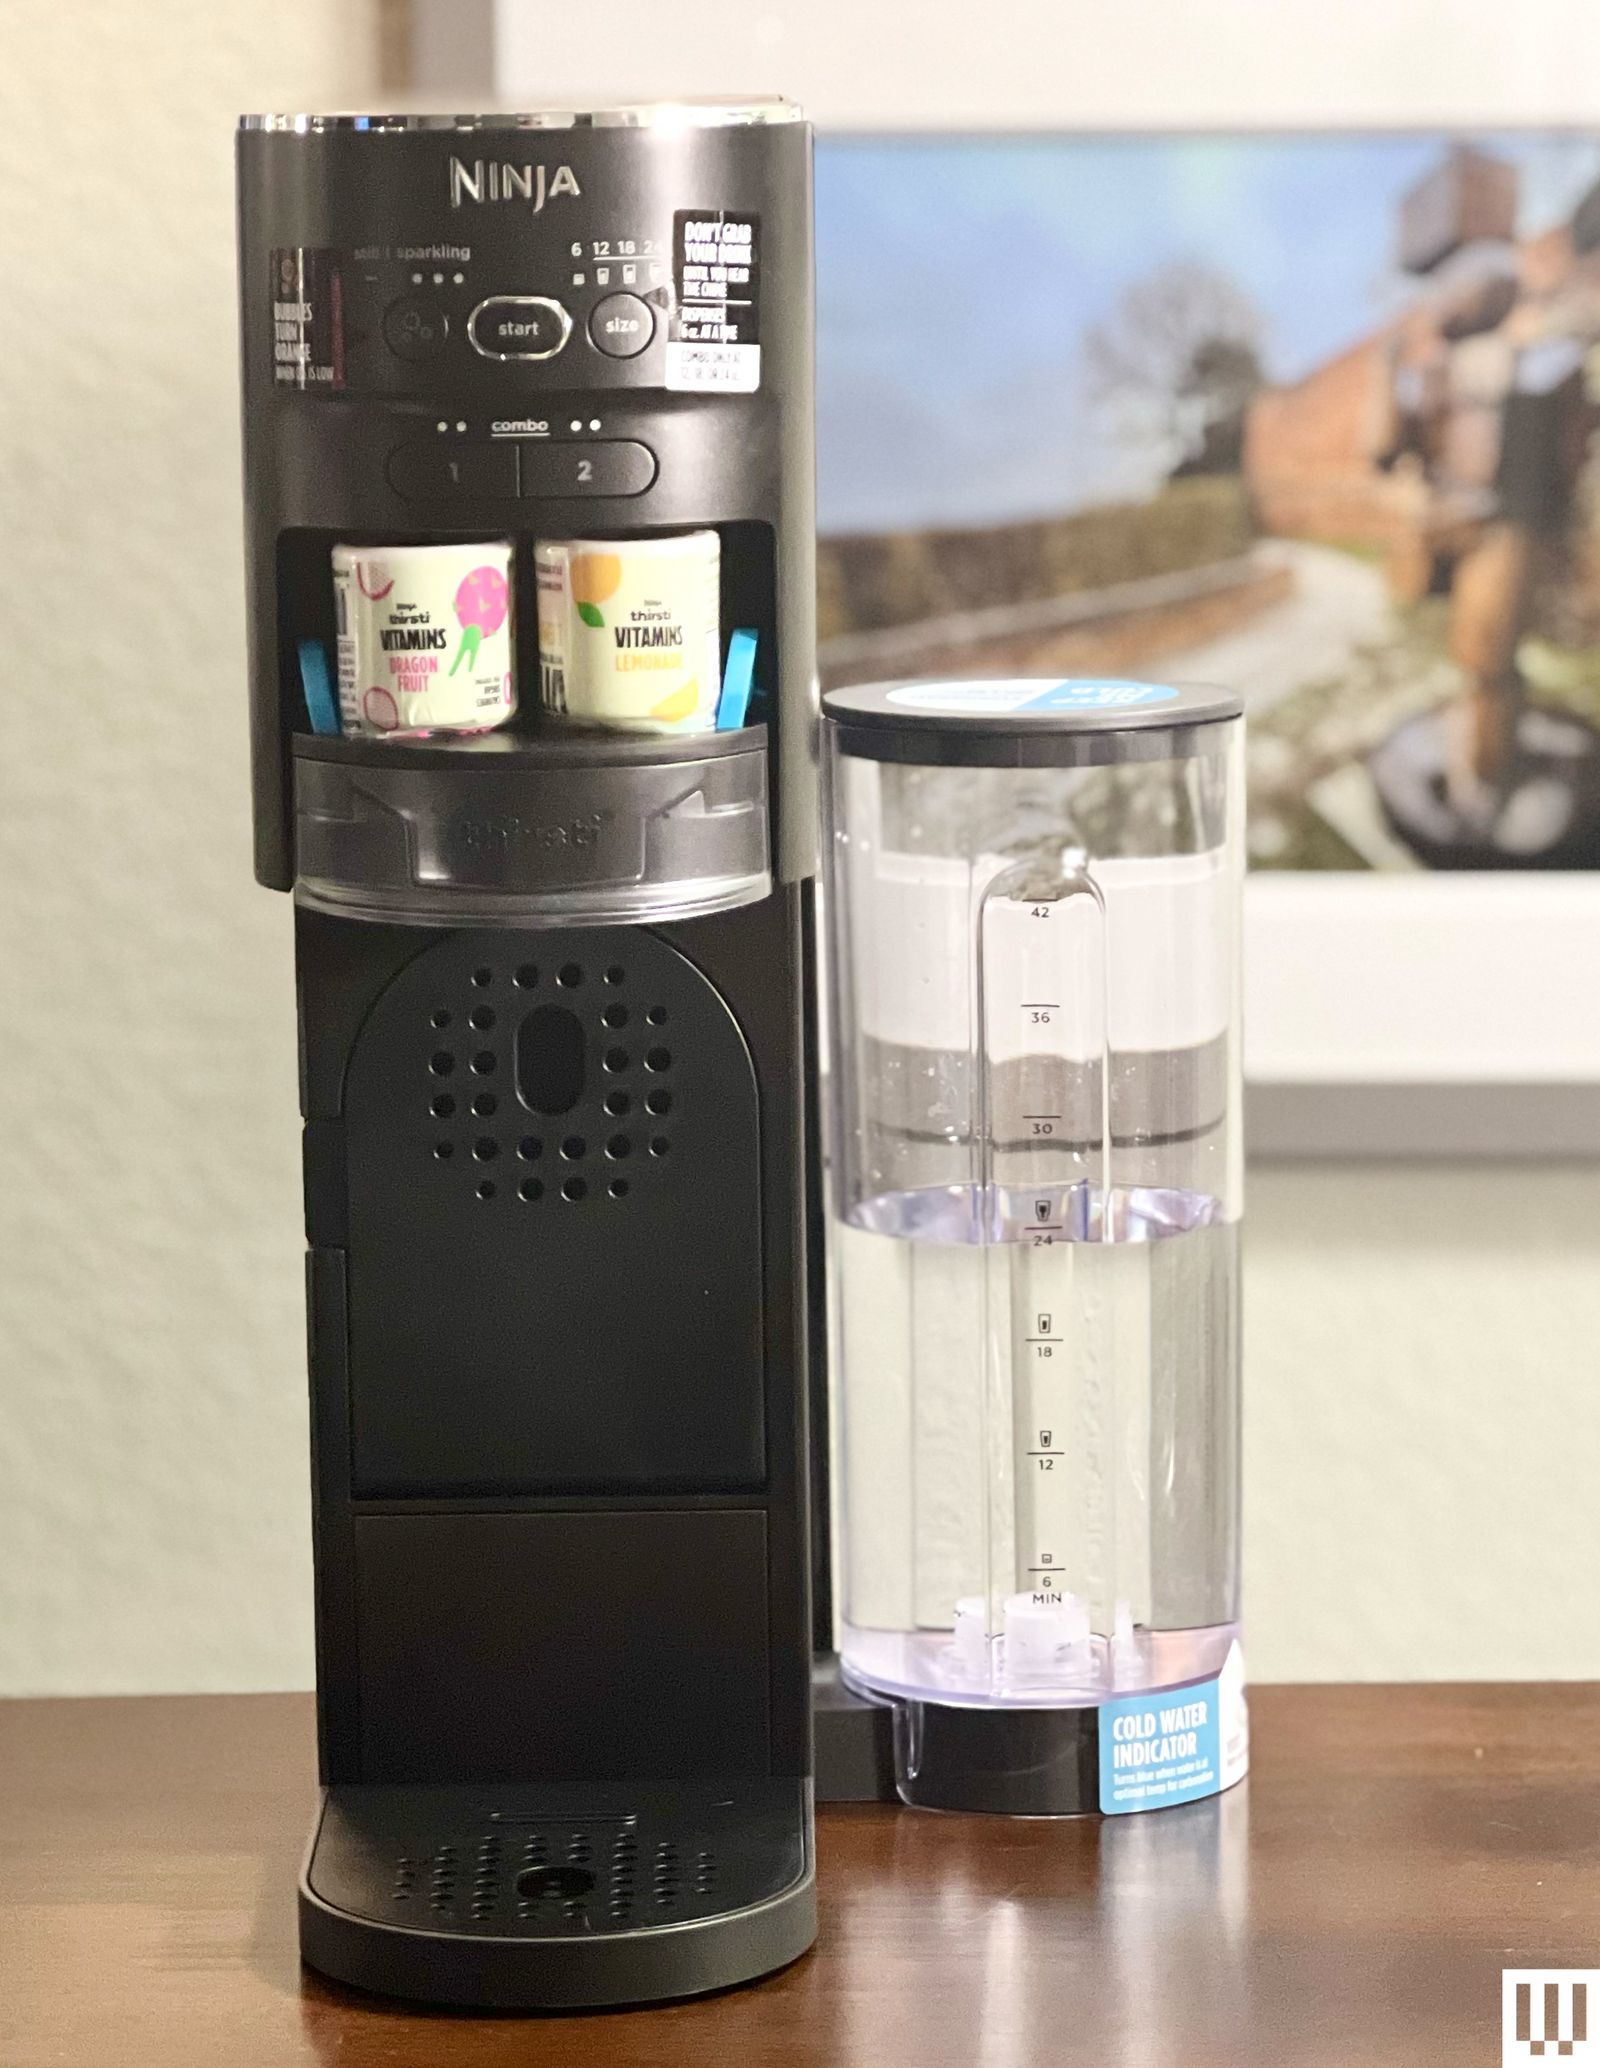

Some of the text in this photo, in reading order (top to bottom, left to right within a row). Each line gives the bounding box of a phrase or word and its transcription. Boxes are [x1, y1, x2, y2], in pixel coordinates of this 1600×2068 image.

[450, 156, 581, 214] NINJA
[396, 243, 471, 261] sparkling
[571, 242, 582, 257] 6
[593, 241, 610, 255] 12
[617, 240, 635, 254] 18
[499, 321, 540, 336] start
[605, 317, 640, 333] size
[491, 419, 549, 432] combo
[450, 461, 459, 482] 1
[577, 459, 592, 481] 2
[389, 612, 430, 625] thirsti
[631, 608, 671, 622] thirsti
[380, 628, 447, 651] VITAMINS
[615, 626, 683, 648] VITAMINS
[389, 656, 438, 674] DRAGON
[397, 675, 429, 692] FRUIT
[1031, 907, 1050, 918] 42
[1031, 1013, 1050, 1024] 36
[1032, 1124, 1053, 1135] 30
[1034, 1235, 1053, 1247] 24
[1037, 1347, 1052, 1358] 18
[1038, 1459, 1054, 1470] 12
[1042, 1577, 1051, 1588] 6
[1032, 1593, 1062, 1604] MIN
[1113, 1701, 1208, 1741] COLD WATER
[1113, 1732, 1197, 1769] INDICATOR
